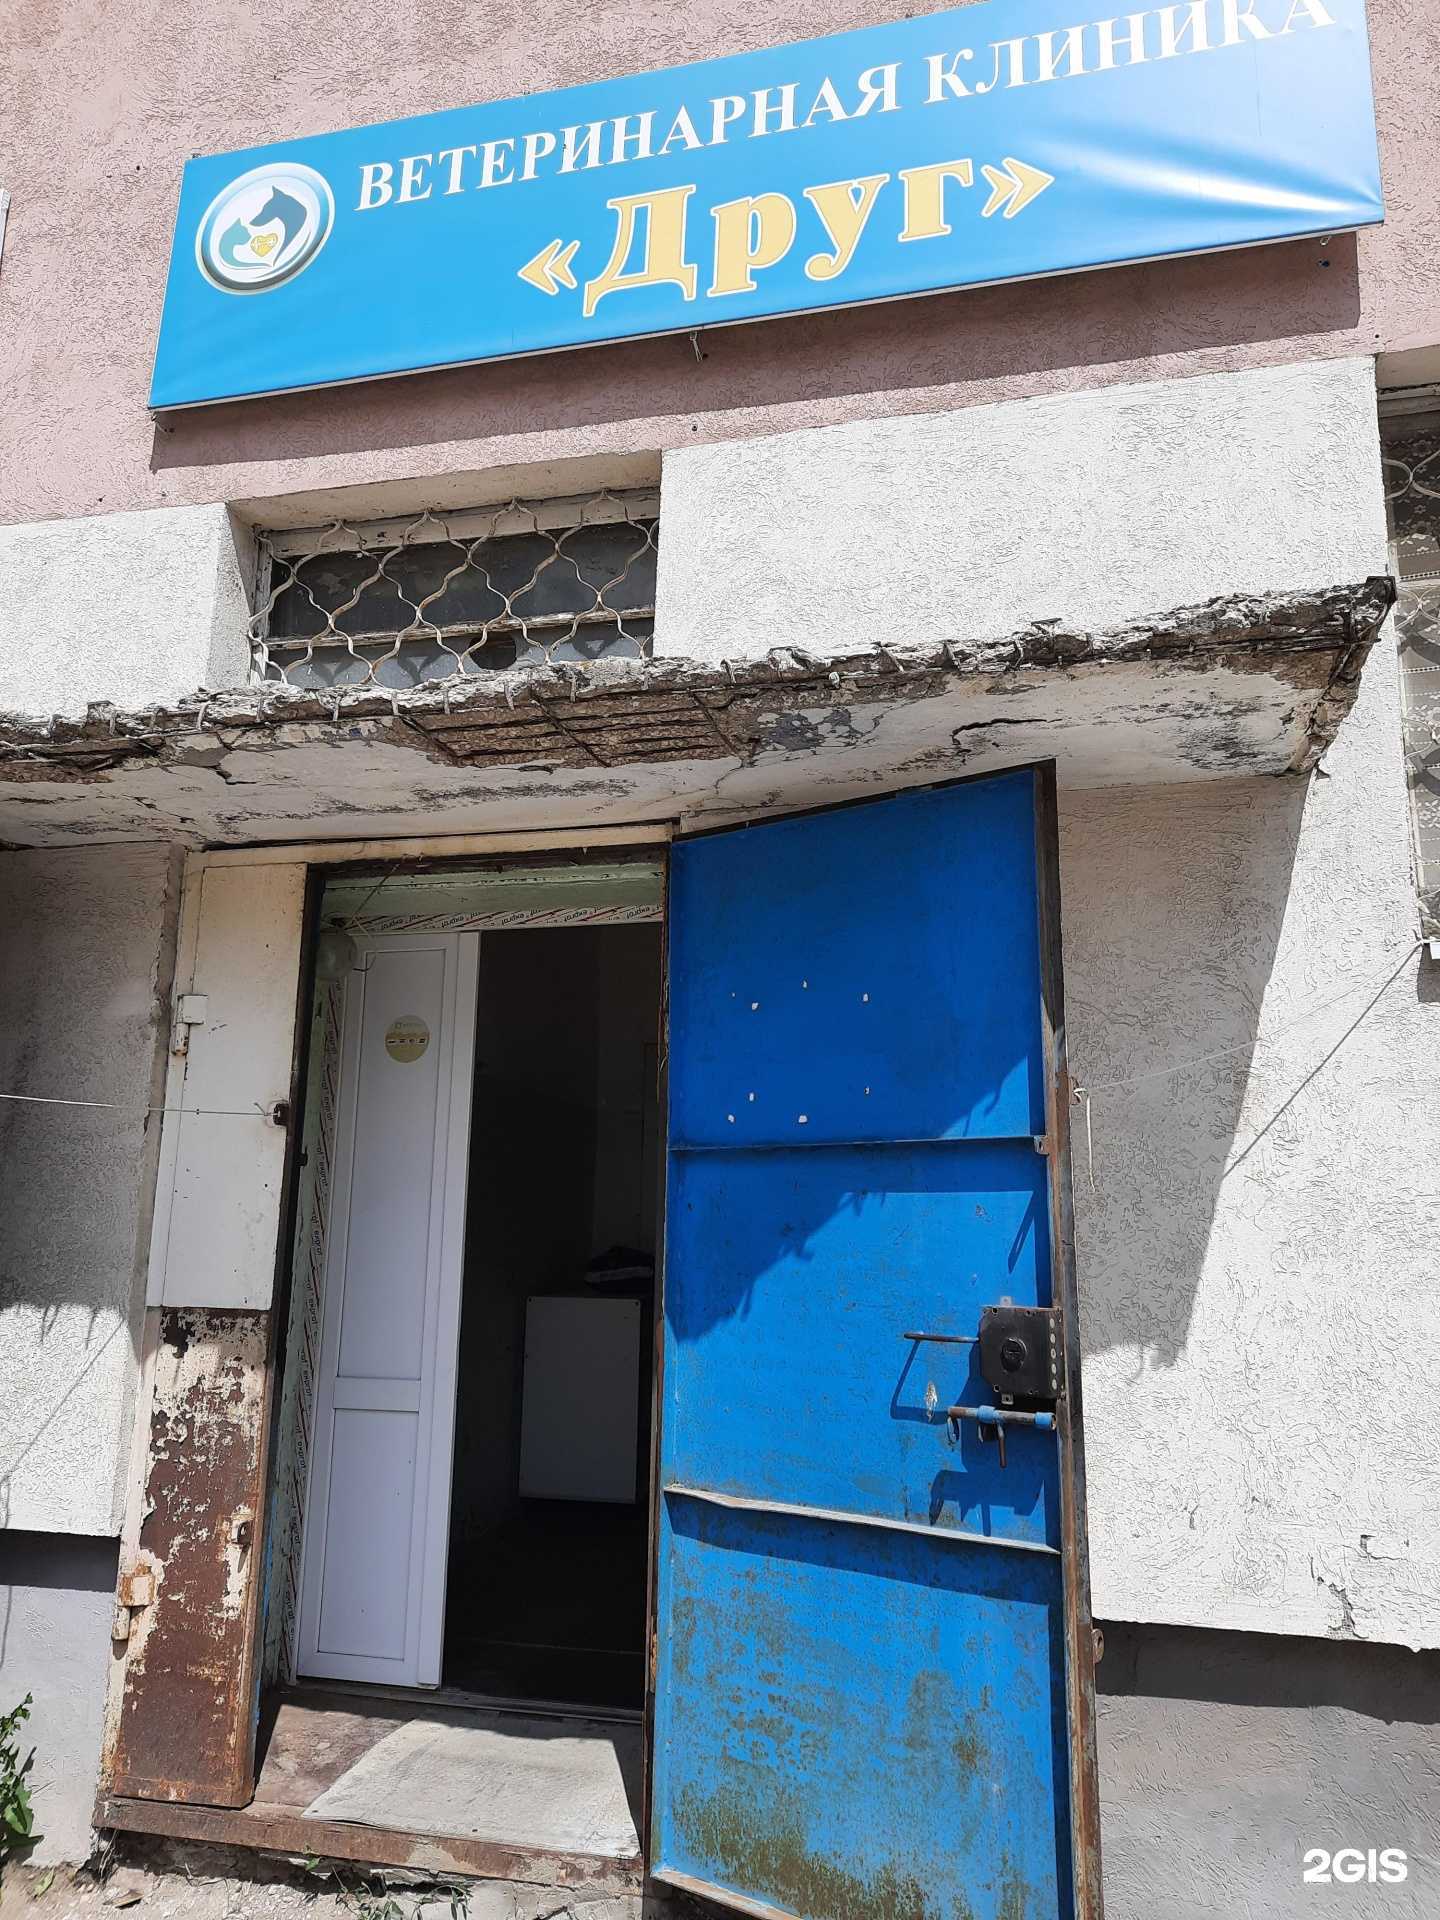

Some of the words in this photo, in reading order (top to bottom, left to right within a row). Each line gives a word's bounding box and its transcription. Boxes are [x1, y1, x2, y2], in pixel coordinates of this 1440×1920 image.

[354, 61, 903, 211] ВЕТЕРИНАРНАЯ
[923, 0, 1337, 104] КЛИНИКА
[517, 156, 1056, 318] «Друг»
